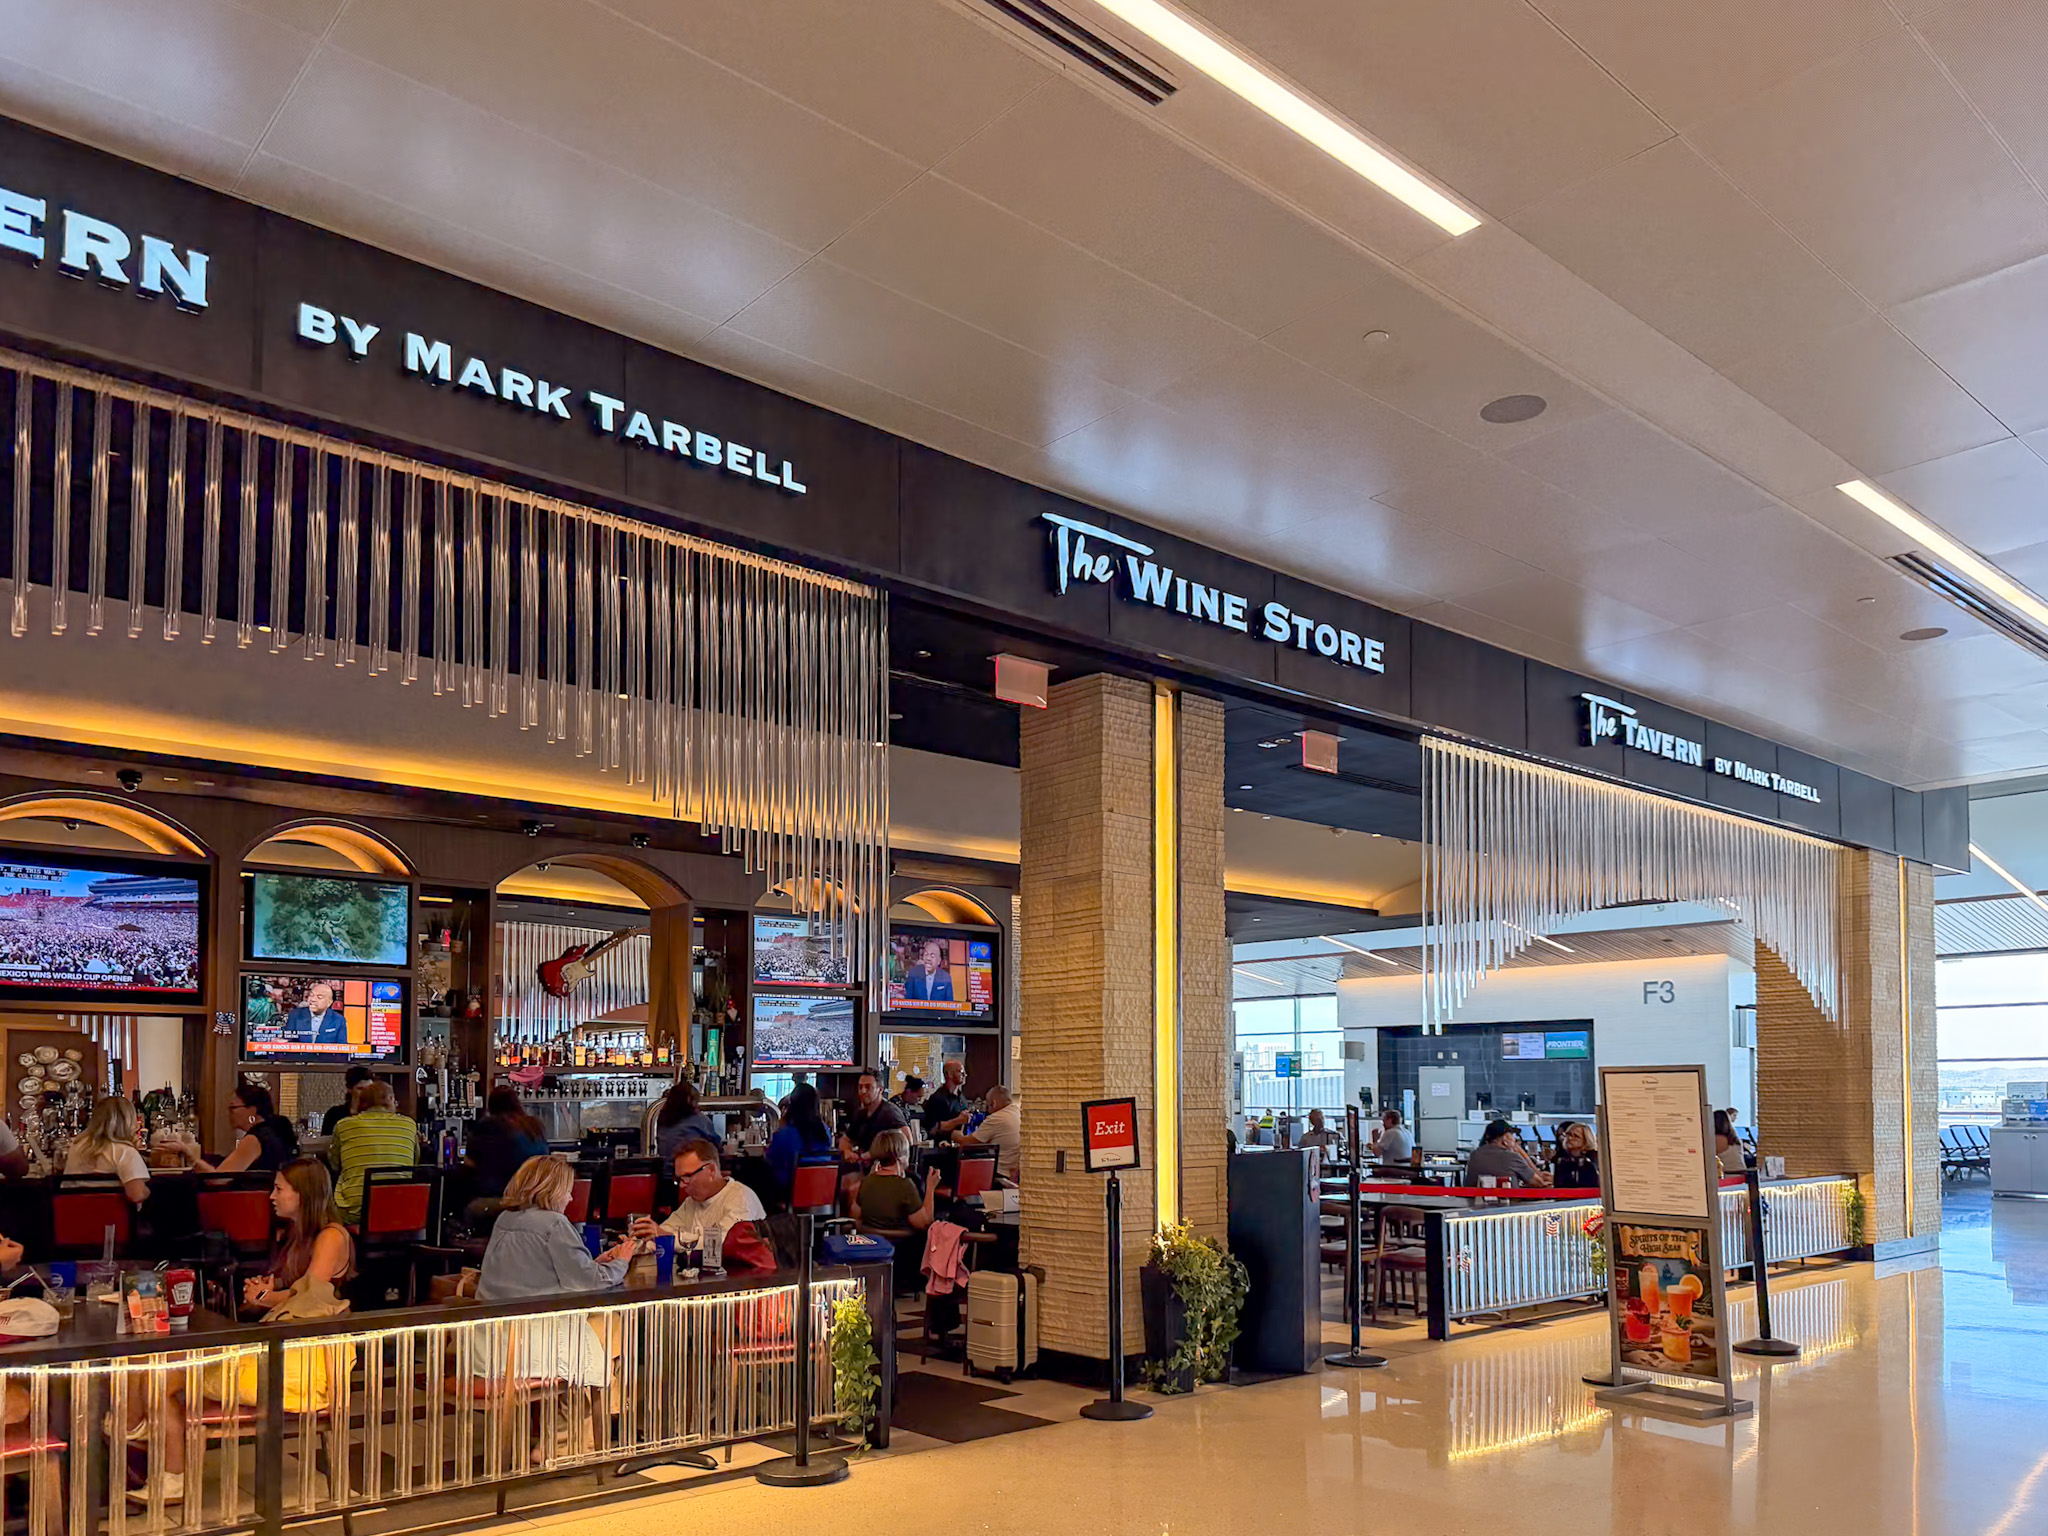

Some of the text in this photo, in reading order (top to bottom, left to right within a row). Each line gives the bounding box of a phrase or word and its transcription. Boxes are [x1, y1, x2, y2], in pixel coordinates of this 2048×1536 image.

[298, 302, 380, 355] BY
[406, 331, 571, 419] MARK
[589, 391, 808, 494] TARBELL
[1042, 512, 1385, 674] The WINE STORE
[1581, 692, 1821, 803] The TAVERN BY MARK TARBELL
[29, 971, 52, 979] WINS
[52, 972, 82, 980] WORLD
[83, 973, 100, 981] CUP
[102, 974, 133, 983] OPENER
[1643, 981, 1675, 1004] F3
[1546, 1040, 1584, 1048] FRONTIER
[1095, 1121, 1126, 1136] Exit
[1629, 1233, 1687, 1249] SPIRITS OF THE
[1662, 1243, 1681, 1254] SEAS
